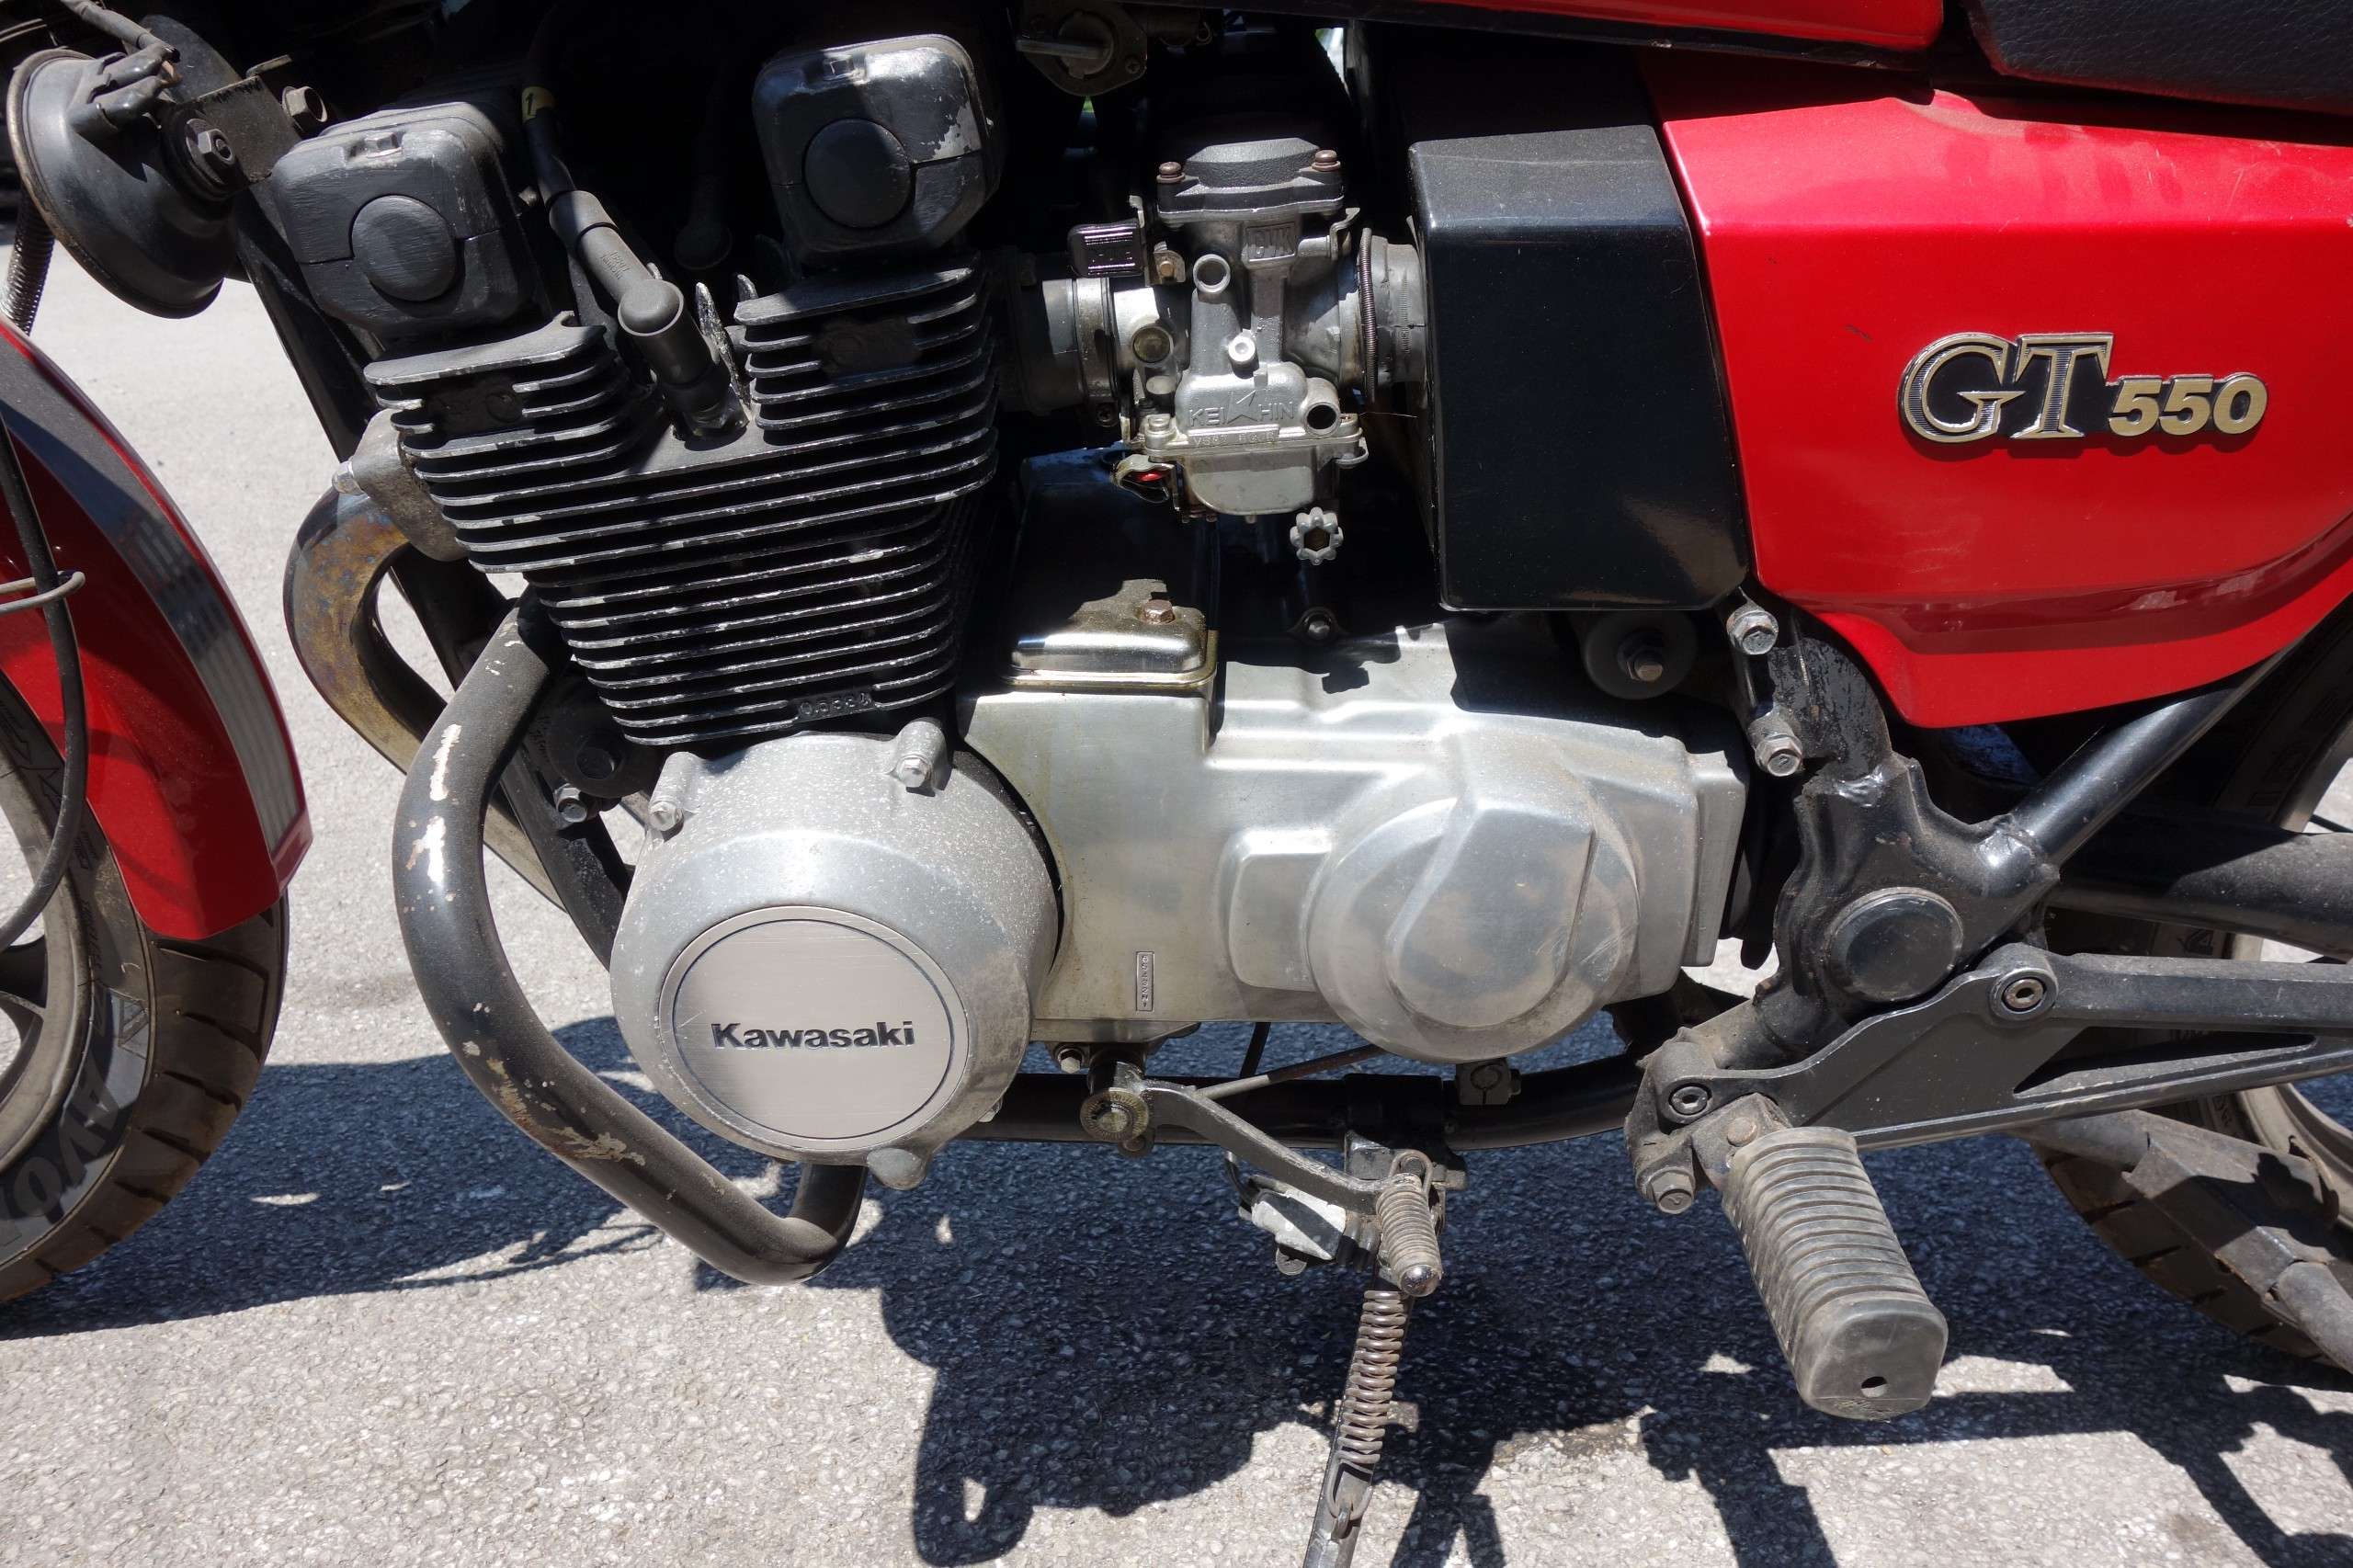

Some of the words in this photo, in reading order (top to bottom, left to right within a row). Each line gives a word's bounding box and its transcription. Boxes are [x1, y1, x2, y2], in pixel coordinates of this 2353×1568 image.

[1897, 332, 2114, 443] GT
[2108, 372, 2268, 437] 550
[710, 1020, 915, 1049] Kawasaki
